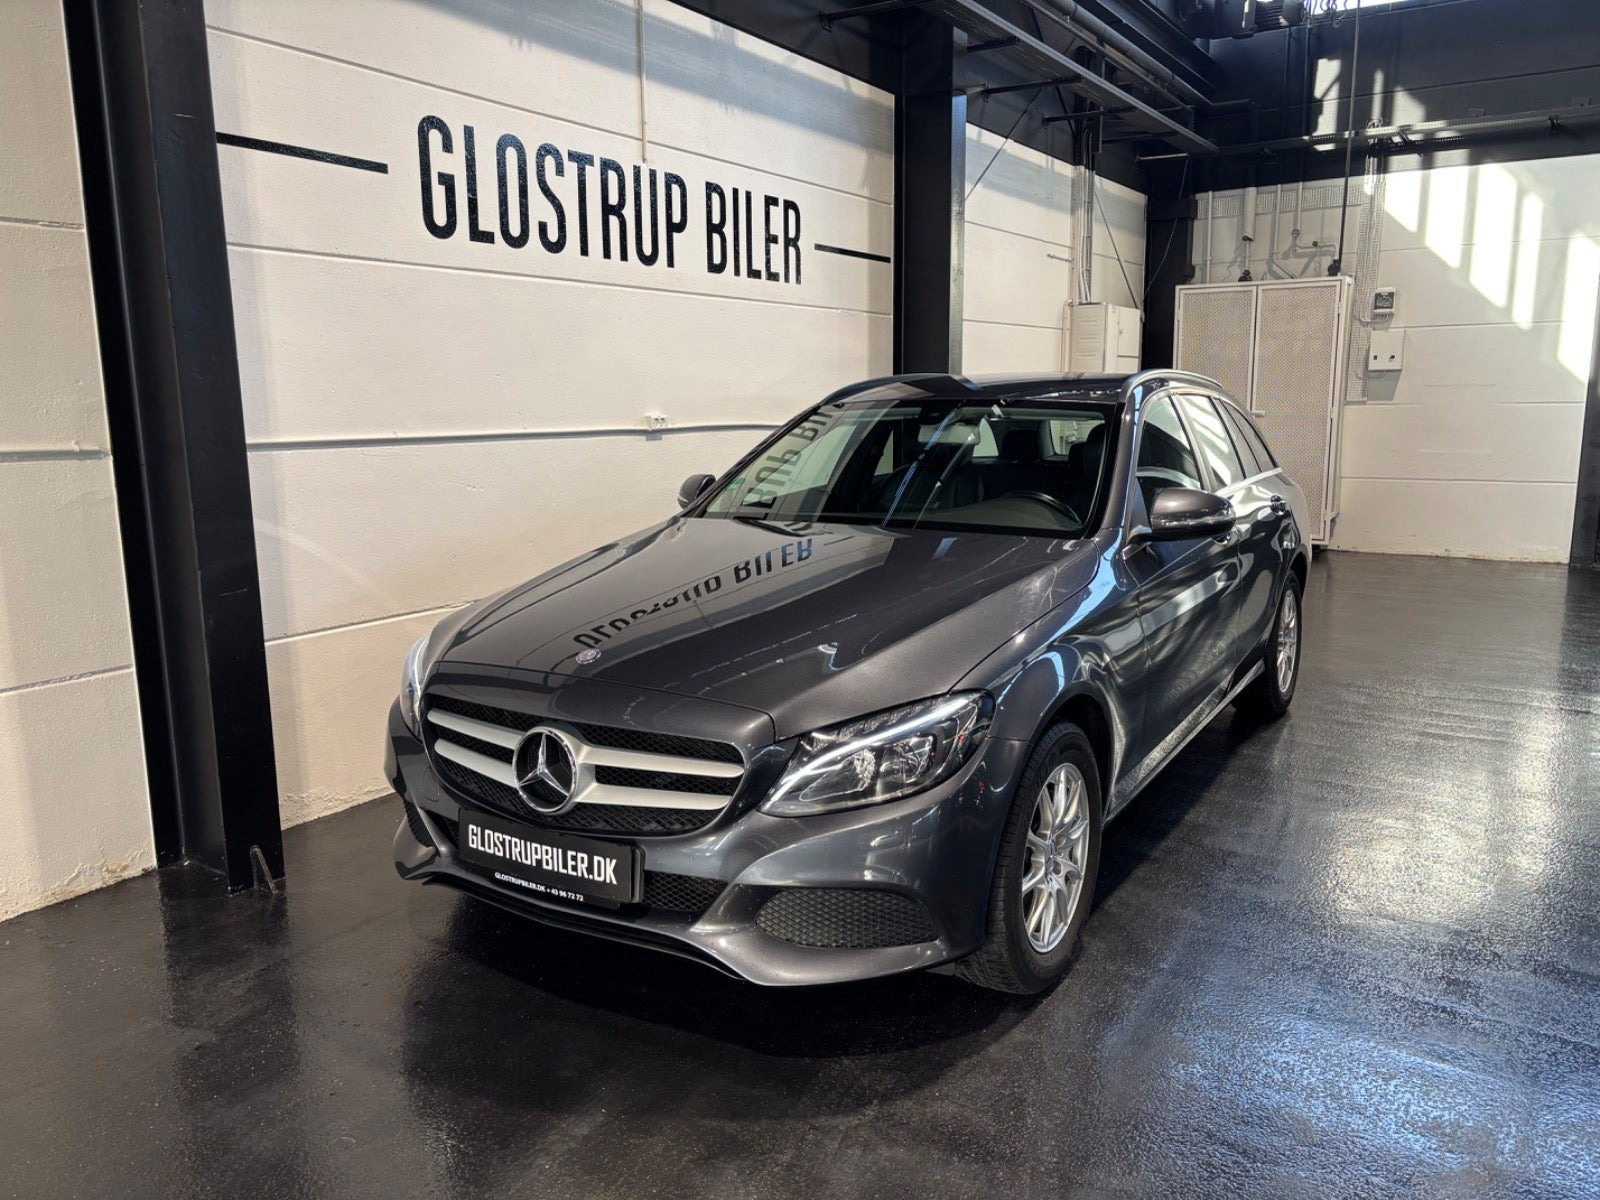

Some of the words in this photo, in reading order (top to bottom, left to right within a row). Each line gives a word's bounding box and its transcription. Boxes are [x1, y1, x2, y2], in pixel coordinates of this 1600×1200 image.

[417, 115, 688, 268] GLOSTRUP
[704, 182, 801, 285] BILER
[469, 824, 617, 885] GLOSTRUPBILER.DK
